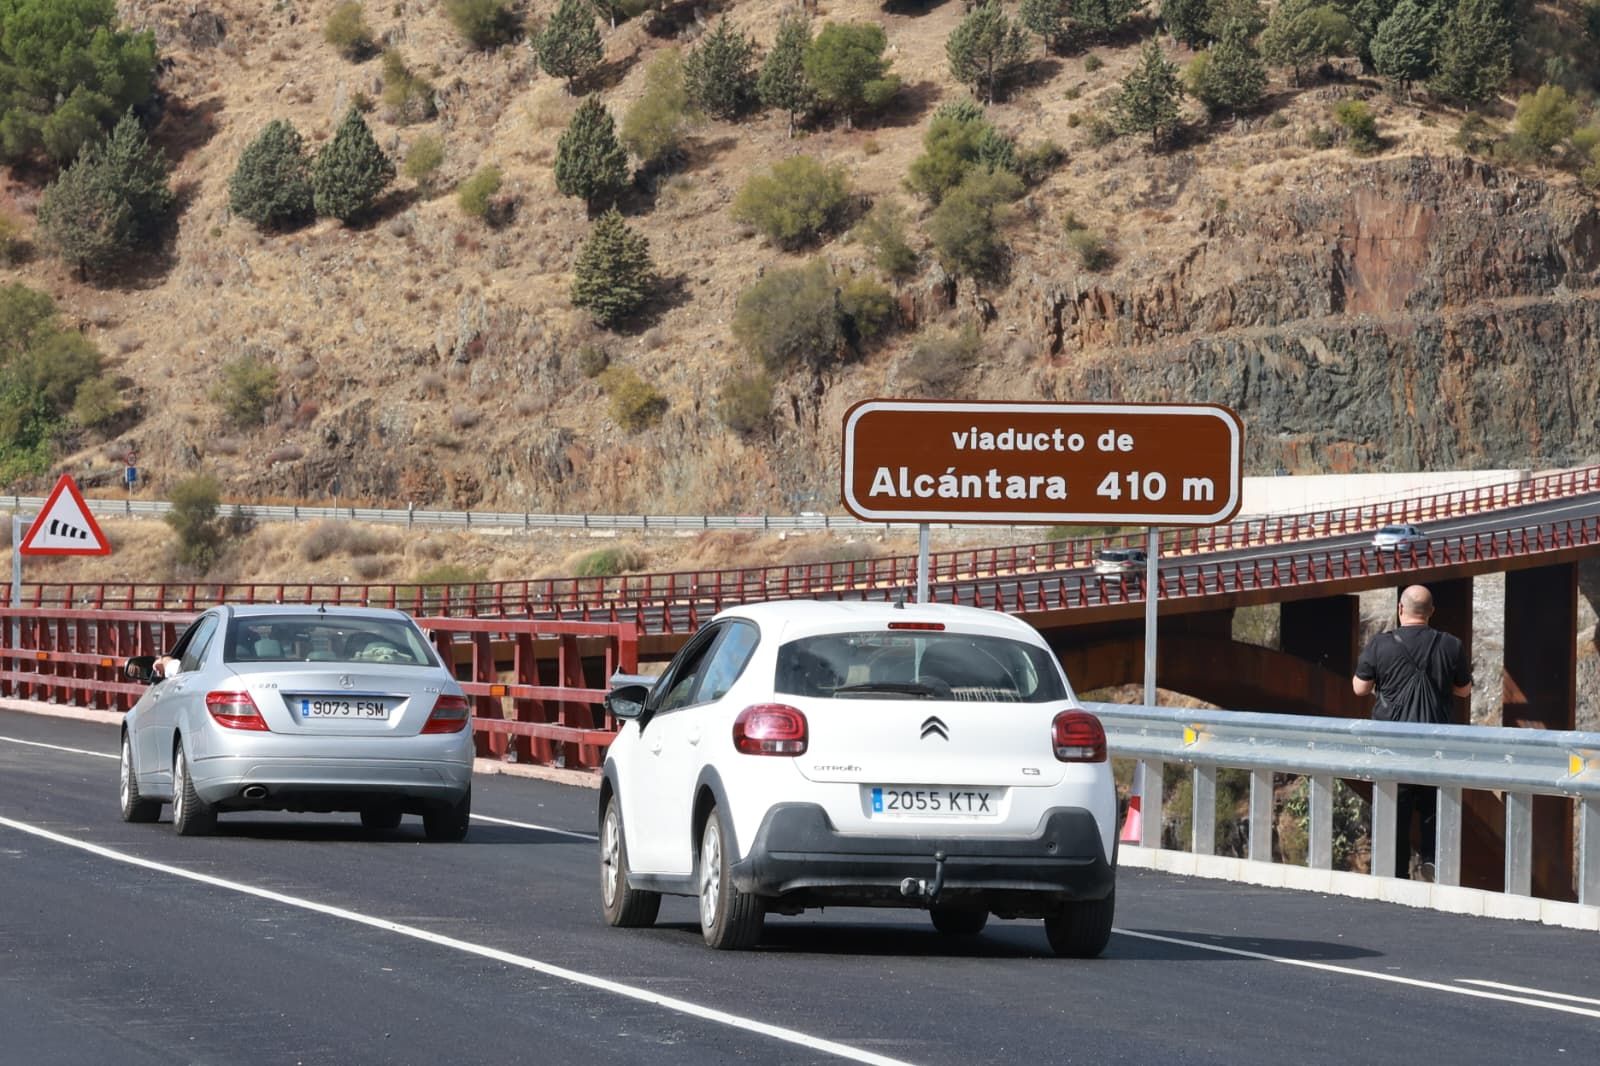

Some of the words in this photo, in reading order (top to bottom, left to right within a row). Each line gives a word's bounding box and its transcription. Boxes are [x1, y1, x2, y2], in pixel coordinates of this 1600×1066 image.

[952, 427, 1085, 451] viaducto
[1097, 429, 1134, 453] de
[869, 466, 1067, 499] Alcántara
[1096, 471, 1167, 500] 410
[1182, 477, 1215, 501] m
[313, 702, 350, 716] 9073
[357, 702, 384, 717] FSM
[887, 791, 942, 810] 2055
[949, 792, 990, 812] KTX
